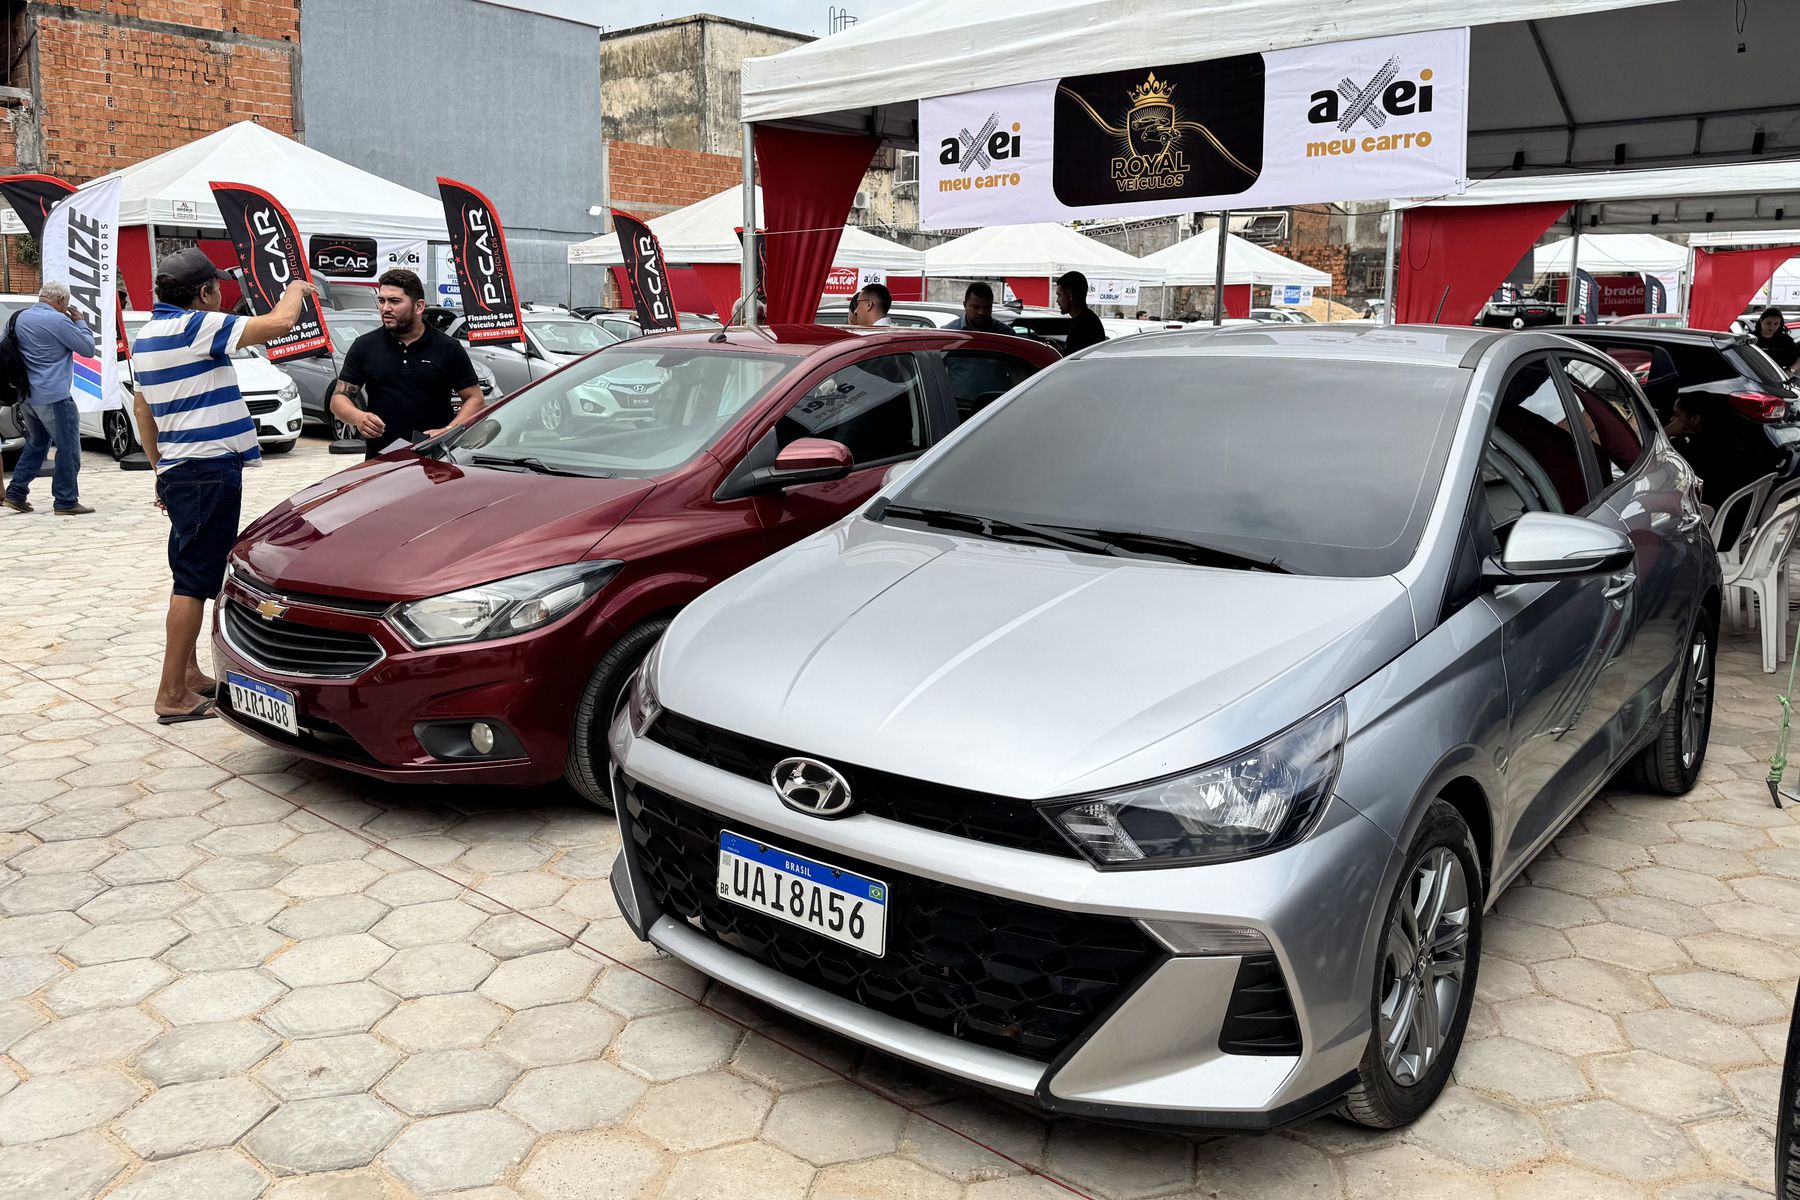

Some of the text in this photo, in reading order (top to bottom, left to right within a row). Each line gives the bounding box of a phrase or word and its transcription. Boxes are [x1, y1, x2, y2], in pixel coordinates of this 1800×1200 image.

[1306, 131, 1432, 157] meu carro
[1111, 151, 1191, 178] ROYAL
[939, 172, 1021, 192] meu carro
[1116, 174, 1184, 192] VEÍCULOS
[101, 223, 109, 283] MOTORS
[318, 255, 369, 268] P-CAR
[468, 207, 501, 304] P-CAR
[68, 206, 103, 358] EALIZE
[639, 235, 669, 320] P-CAR
[235, 686, 289, 727] PIR1J88
[785, 860, 811, 877] BRASIL
[720, 882, 729, 896] BR
[733, 858, 865, 940] UAI8A56
